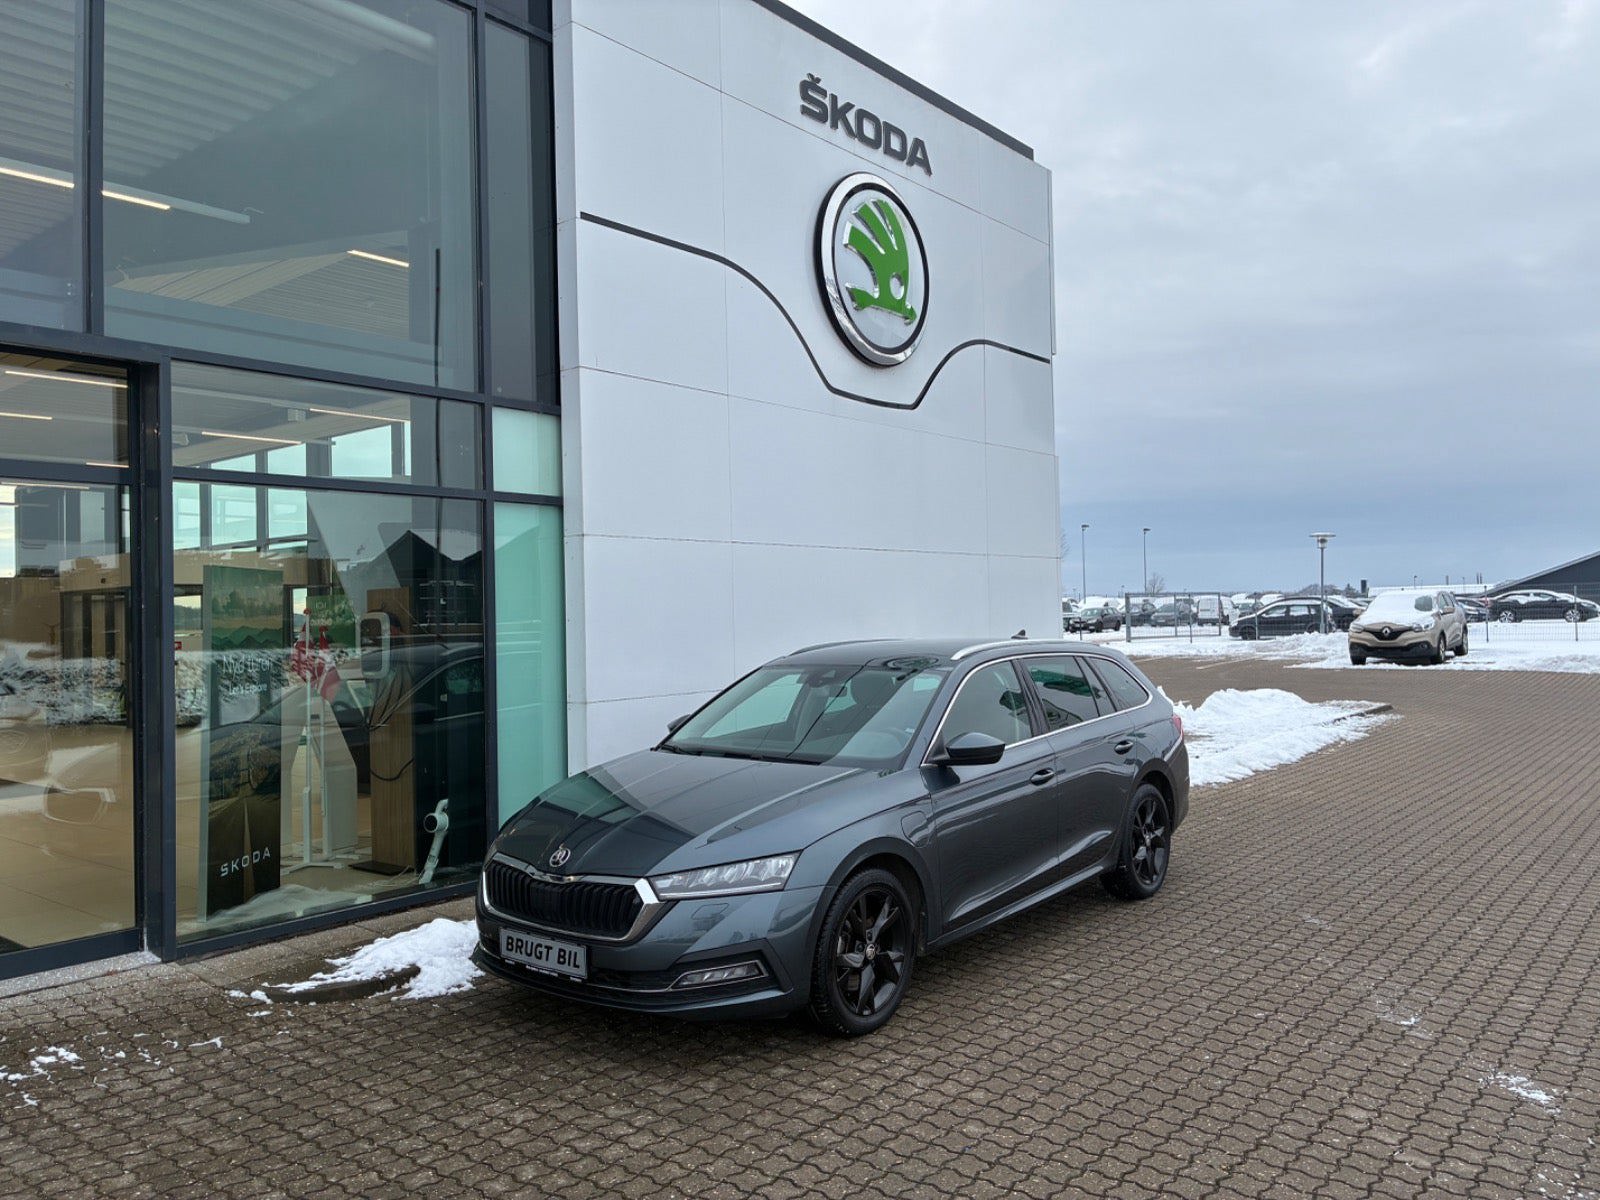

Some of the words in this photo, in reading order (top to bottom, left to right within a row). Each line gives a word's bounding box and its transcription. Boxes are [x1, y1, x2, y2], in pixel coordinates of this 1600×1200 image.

[799, 72, 932, 177] ŠKODA
[506, 935, 553, 962] BRUGT
[557, 947, 580, 968] BIL
